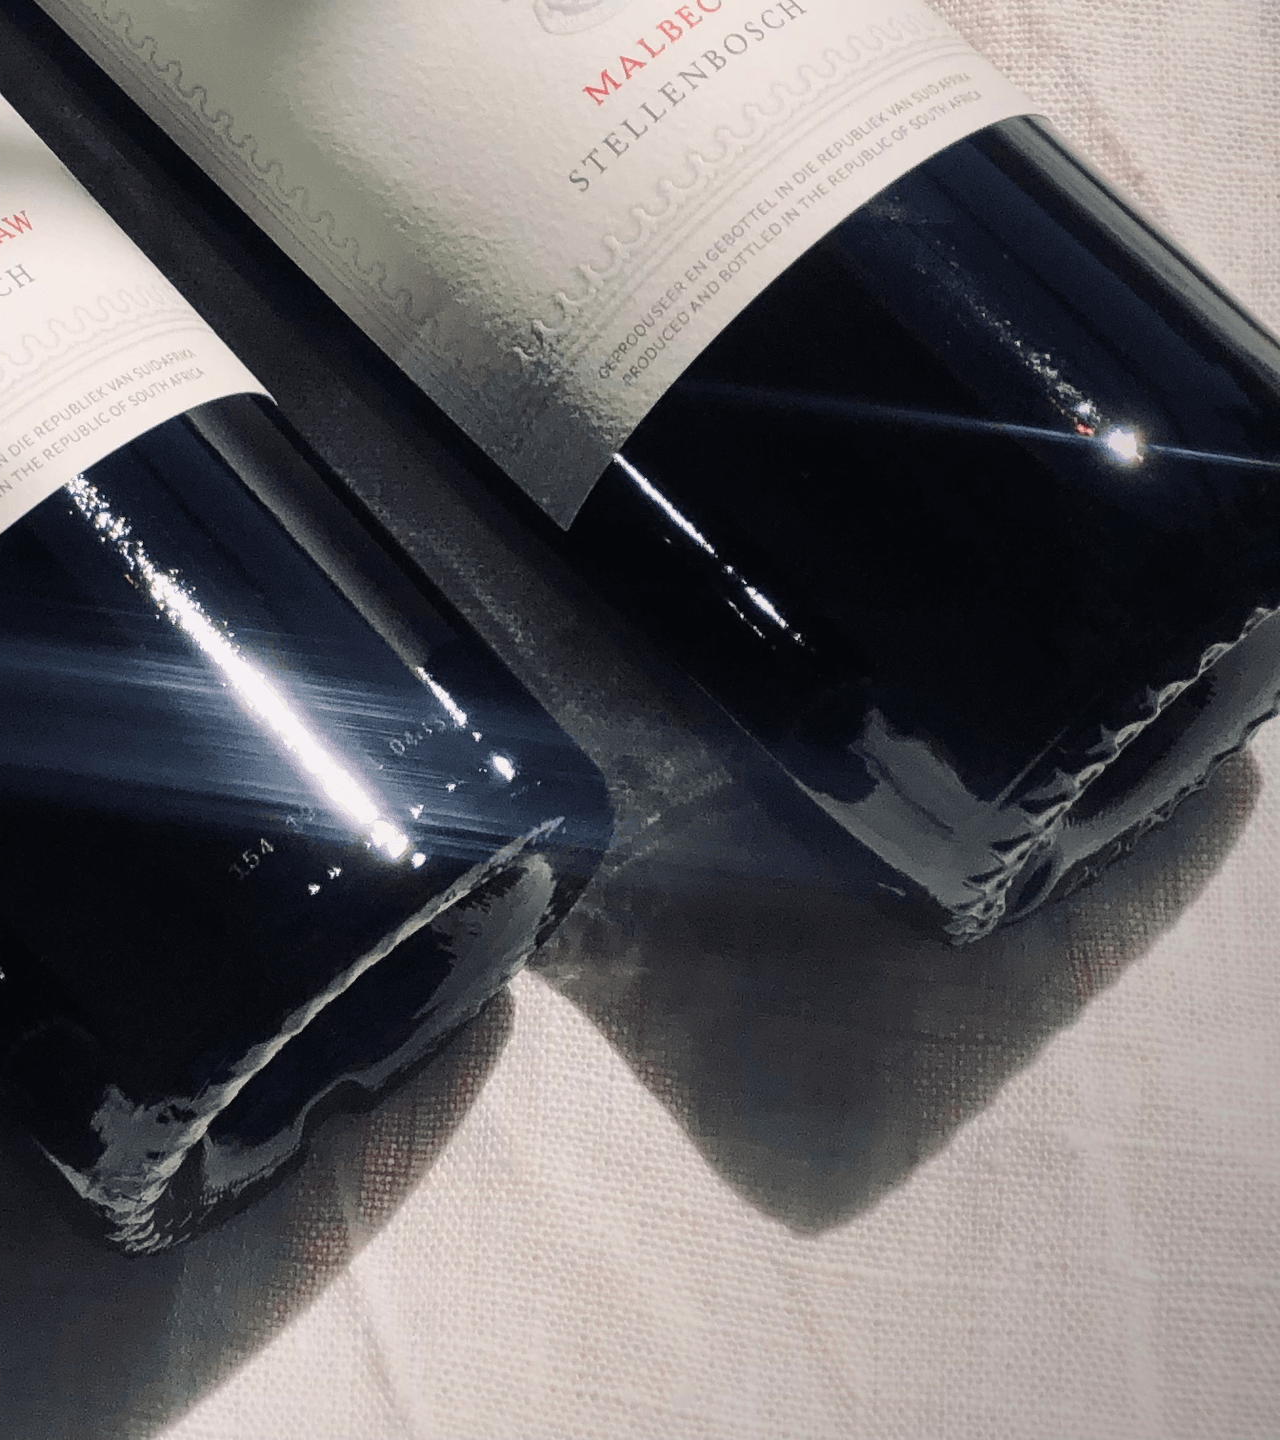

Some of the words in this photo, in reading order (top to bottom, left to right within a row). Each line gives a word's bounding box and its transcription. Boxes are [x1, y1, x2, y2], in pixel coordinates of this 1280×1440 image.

[598, 280, 687, 379] GEPRODUSEER
[685, 260, 707, 282] EN
[706, 198, 778, 262] GEBOTTEL
[775, 181, 794, 200] IN
[792, 161, 819, 185] DIE
[816, 112, 890, 166] REPUBLIEK
[887, 98, 914, 116] VAN
[622, 311, 690, 387] PRODUCED
[689, 280, 721, 314] AND
[718, 221, 783, 283] BOTTLED
[781, 208, 801, 227] IN
[798, 183, 830, 210] THE
[827, 136, 894, 188] REPUBLIC
[891, 125, 910, 142] OF
[909, 103, 949, 131] SOUTH
[948, 89, 983, 110] AFRICA
[7, 433, 35, 457] DIE
[33, 386, 109, 437] REPUBLIEK
[105, 373, 134, 392] VAN
[11, 456, 44, 482] THE
[42, 412, 111, 461] REPUBLIC
[108, 400, 127, 417] OF
[127, 380, 170, 406] SOUTH
[169, 366, 205, 387] AFRICA
